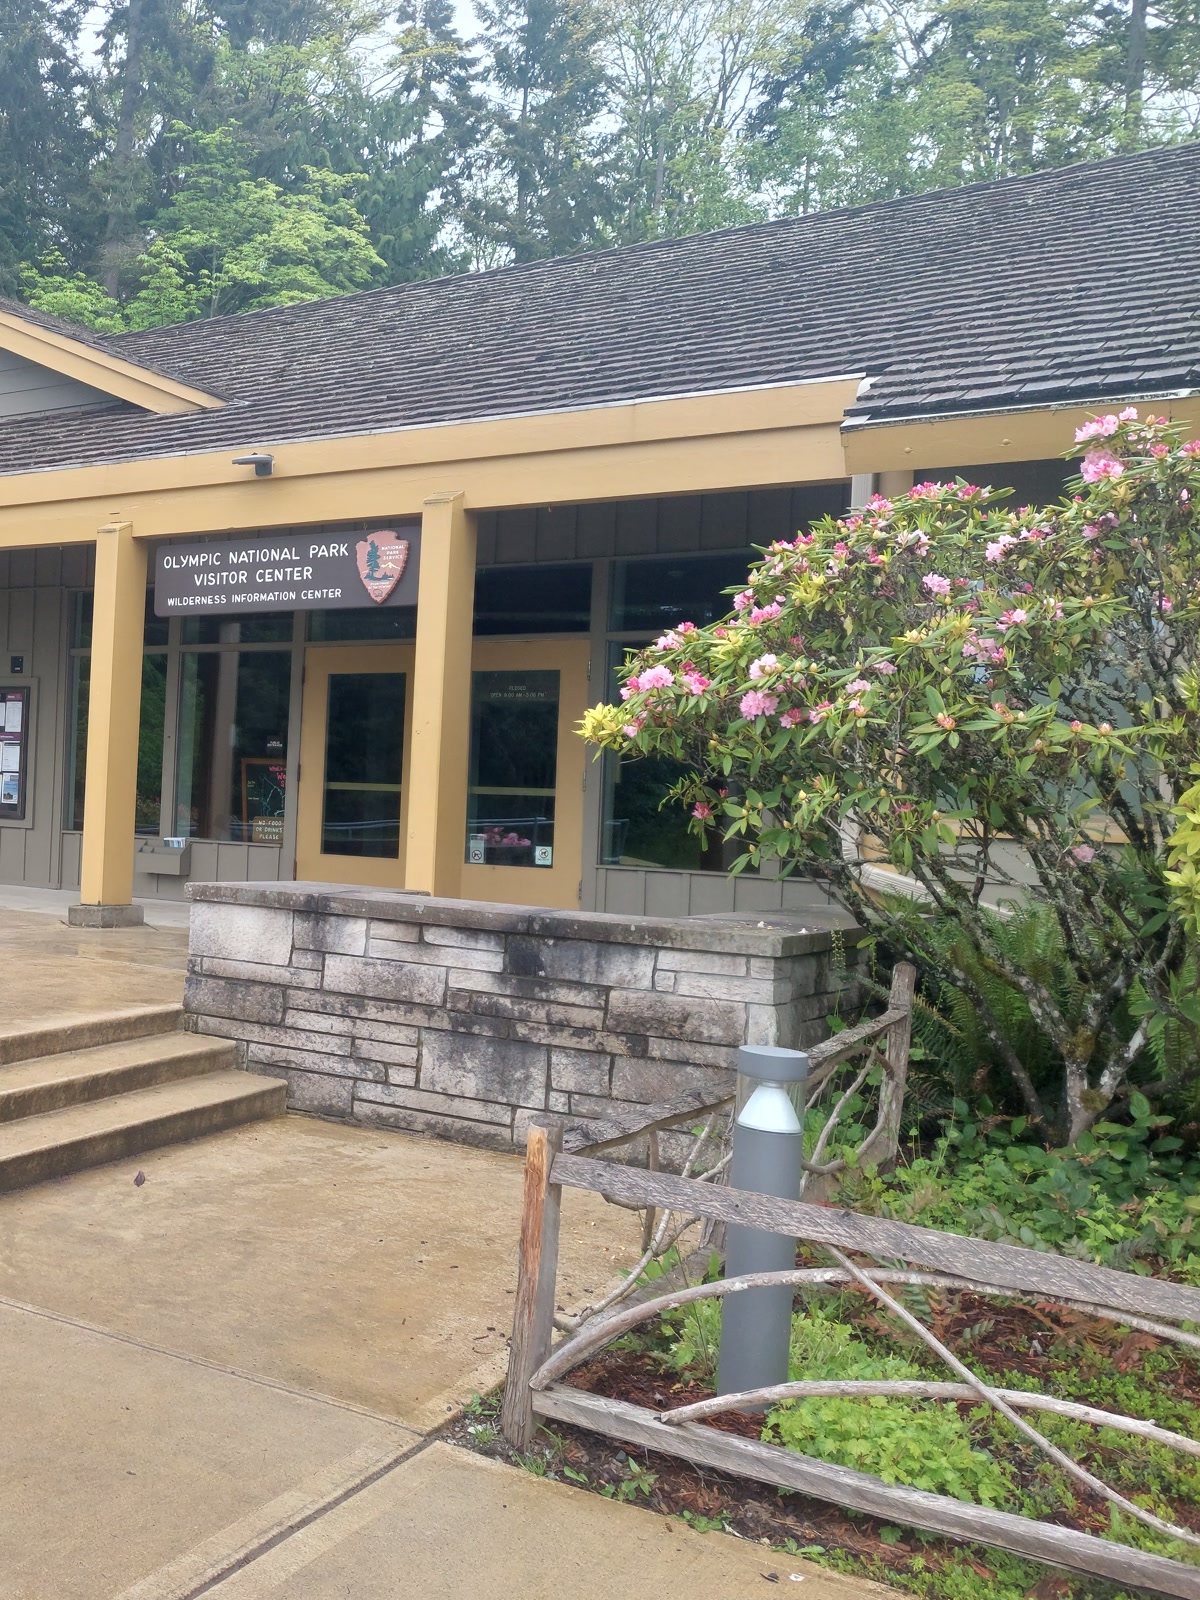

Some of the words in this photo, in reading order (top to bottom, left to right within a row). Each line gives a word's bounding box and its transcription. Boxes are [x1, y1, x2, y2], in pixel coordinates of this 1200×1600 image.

[163, 552, 222, 569] OLYMPIC
[228, 547, 301, 564] NATIONAL
[309, 543, 349, 559] PARK
[194, 571, 248, 587] VISITOR
[255, 566, 313, 583] CENTER
[167, 594, 227, 607] WILDERNESS
[231, 591, 296, 604] INFORMATION
[300, 588, 342, 600] CENTER
